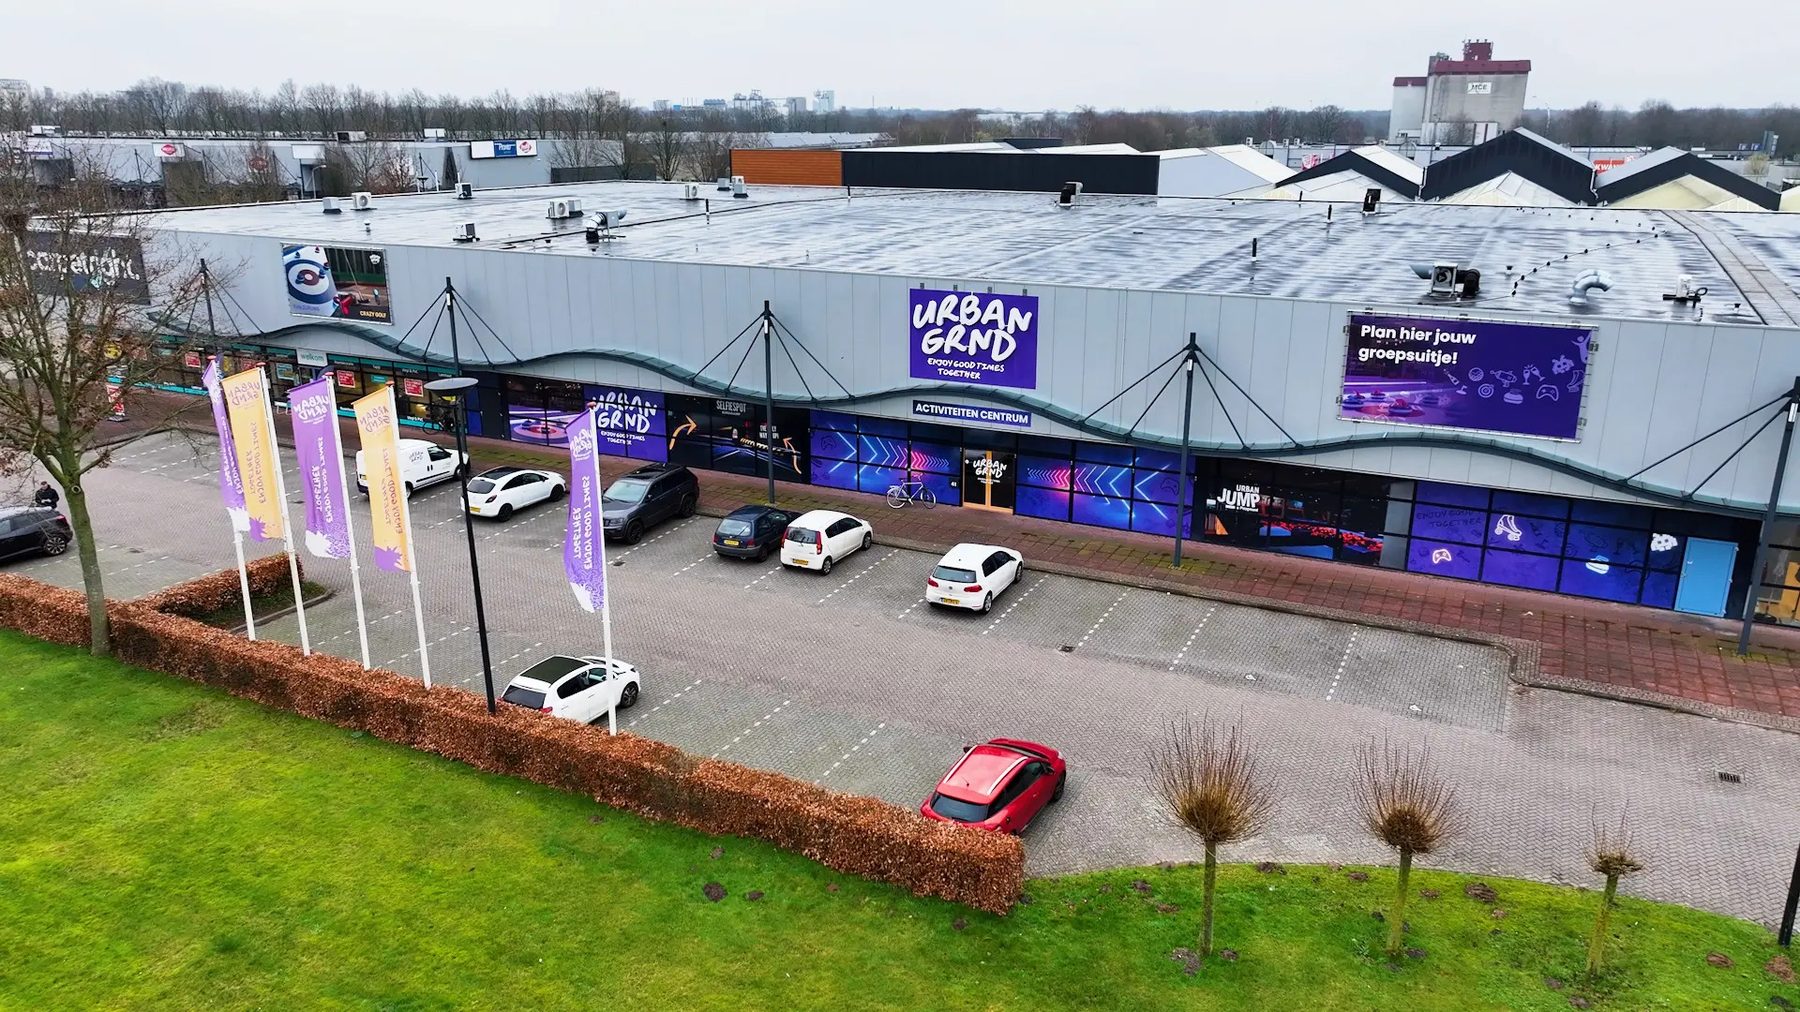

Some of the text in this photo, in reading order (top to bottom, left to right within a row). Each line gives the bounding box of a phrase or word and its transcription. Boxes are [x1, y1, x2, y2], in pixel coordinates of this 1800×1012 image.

[359, 310, 387, 319] CRAZY GOLF
[912, 294, 1033, 335] URBAN
[921, 323, 1017, 362] GRND
[1360, 325, 1477, 346] Plan hier jouw
[300, 353, 325, 363] welkom
[927, 357, 1005, 373] ENJOY GOOD TIMES
[1358, 347, 1459, 367] groepsuitje!
[937, 368, 981, 380] TOGETHER
[592, 391, 657, 418] URBAN
[715, 400, 748, 413] SELFIESPOT
[915, 403, 1028, 424] ACTIVITEITEN CENTRUM
[597, 410, 651, 434] GRND
[972, 459, 1008, 471] URBAN
[975, 467, 1003, 479] GRND
[1216, 488, 1261, 508] JUMP
[1235, 484, 1260, 494] URBAN
